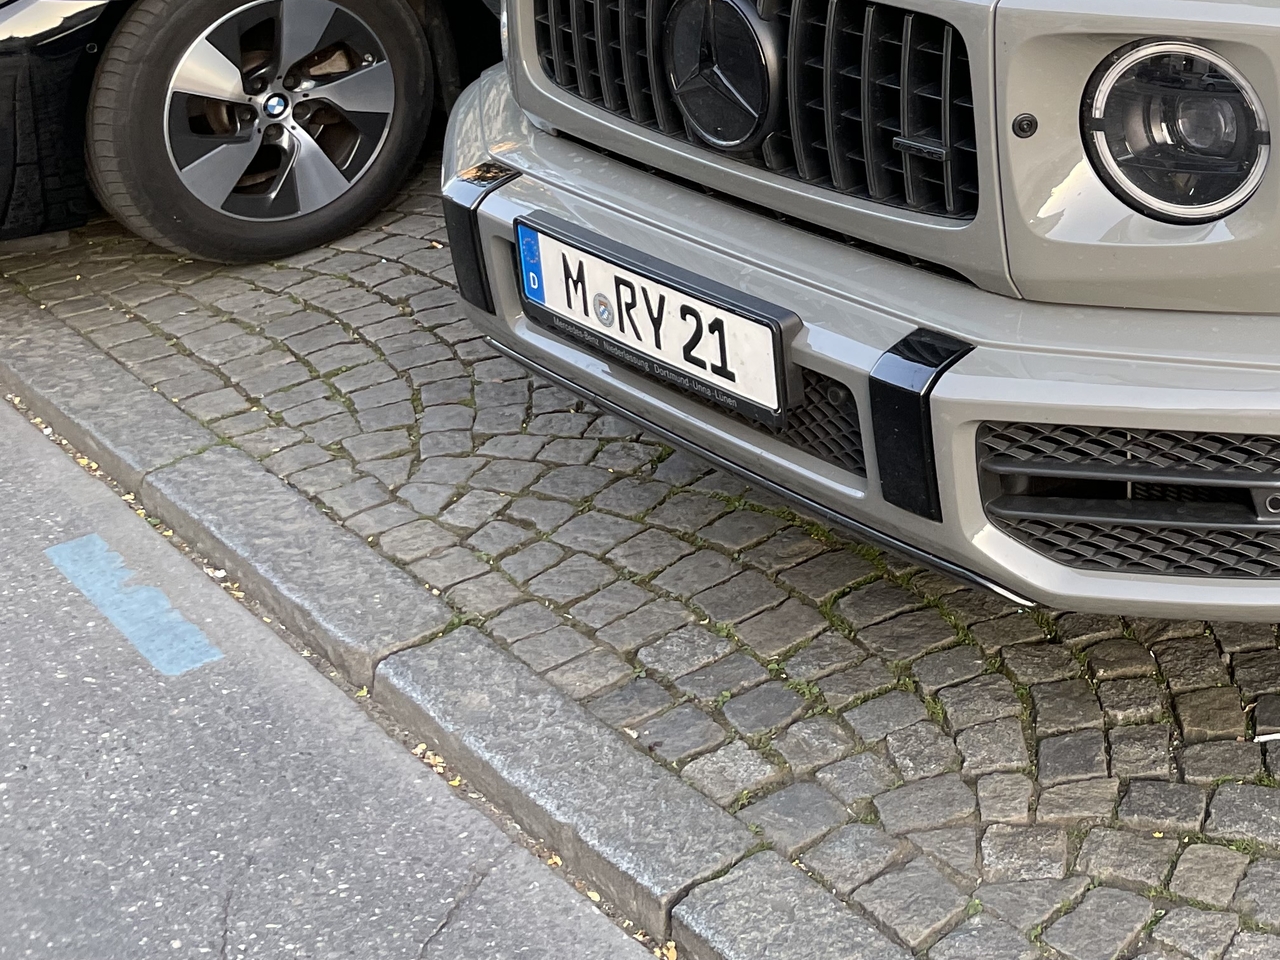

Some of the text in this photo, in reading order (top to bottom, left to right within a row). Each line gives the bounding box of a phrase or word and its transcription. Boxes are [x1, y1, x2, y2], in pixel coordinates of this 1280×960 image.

[529, 272, 538, 290] D
[553, 316, 600, 346] Mercedes-Benz
[603, 340, 650, 372] Niederlassung
[561, 250, 737, 383] M RY 21
